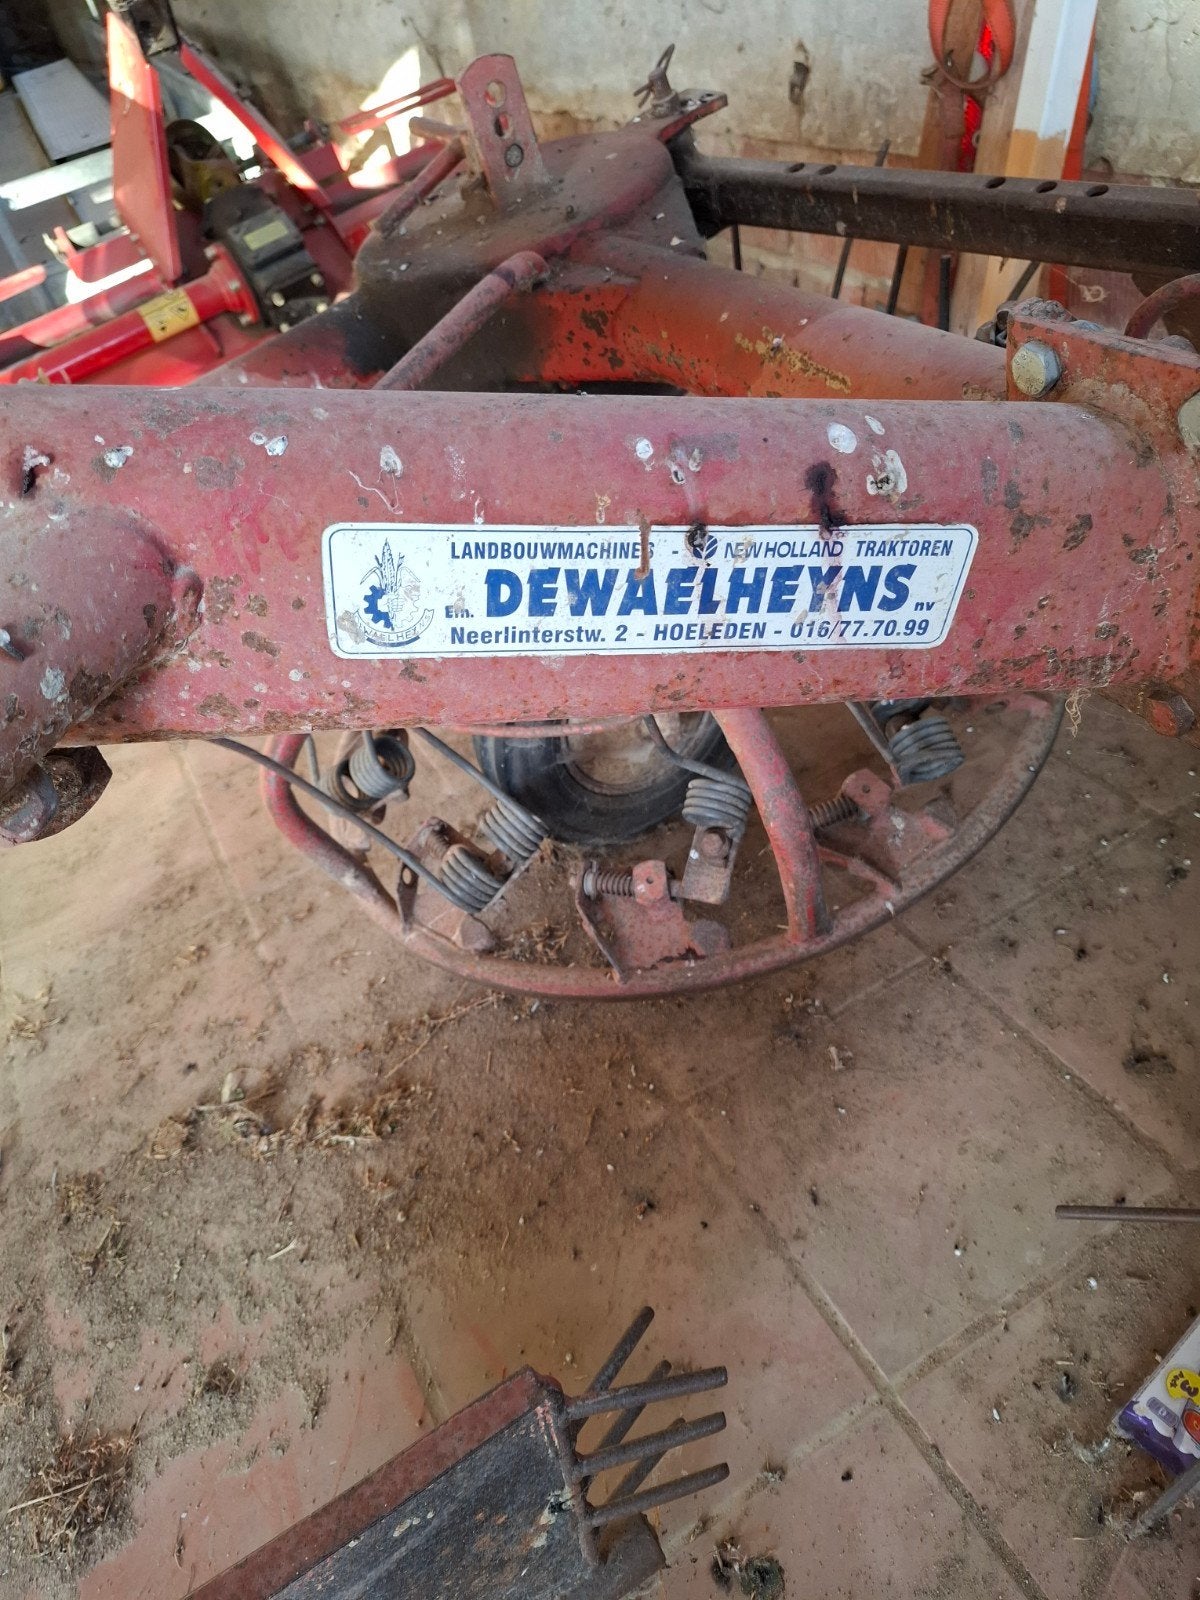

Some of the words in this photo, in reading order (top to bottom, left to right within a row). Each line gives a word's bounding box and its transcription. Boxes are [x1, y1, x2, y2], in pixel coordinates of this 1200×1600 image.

[856, 539, 953, 557] TRAKTOREN
[484, 563, 917, 618] DEWAELHEYNS
[914, 600, 935, 613] nv
[450, 625, 606, 645] Neerlinterstw.
[614, 624, 628, 642] 2
[653, 621, 767, 641] HOELEDEN
[789, 618, 930, 640] 016/77.70.99
